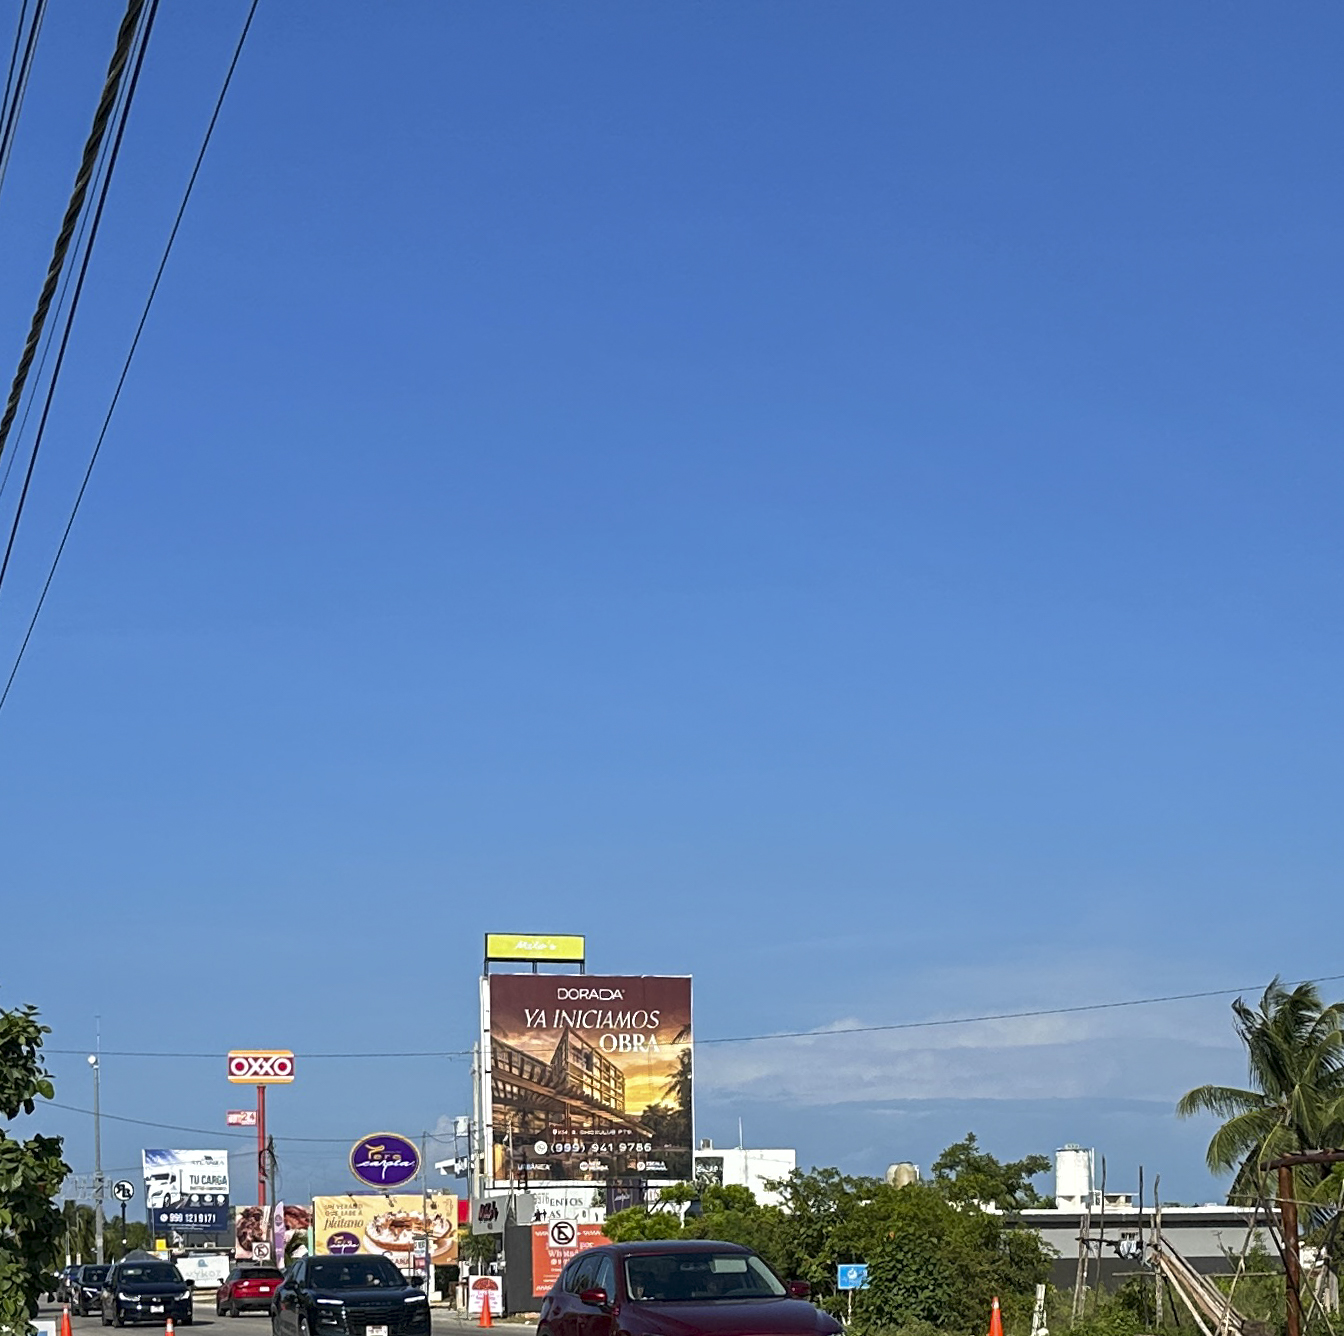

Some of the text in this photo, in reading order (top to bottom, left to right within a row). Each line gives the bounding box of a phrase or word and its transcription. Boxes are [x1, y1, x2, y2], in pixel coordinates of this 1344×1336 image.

[557, 988, 623, 1000] DORADA
[524, 1009, 660, 1029] YA INICIAMOS
[599, 1033, 660, 1053] OBRA
[230, 1057, 292, 1077] OXXO
[591, 1143, 613, 1153] 941
[619, 1143, 652, 1153] 9786
[189, 1175, 227, 1185] TU CARGA
